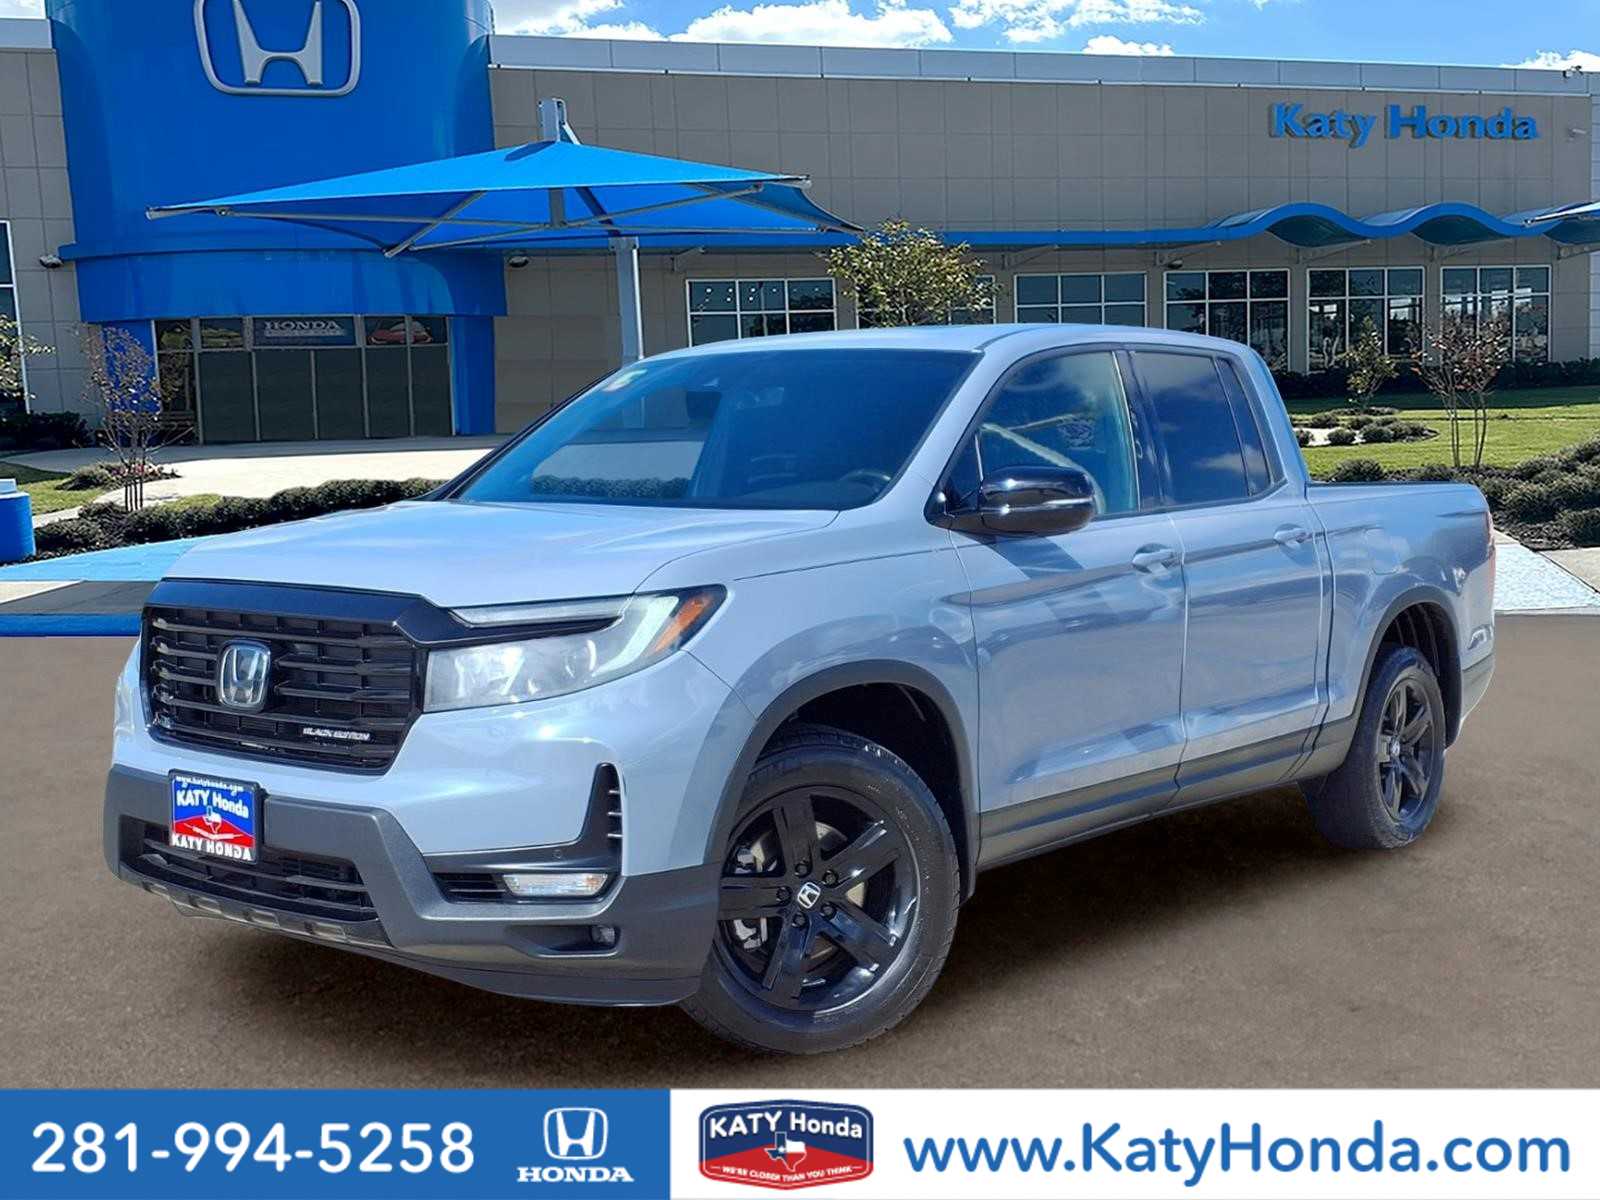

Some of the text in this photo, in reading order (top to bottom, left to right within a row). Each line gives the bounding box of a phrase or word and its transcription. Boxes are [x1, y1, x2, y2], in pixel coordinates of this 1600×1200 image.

[1270, 102, 1539, 148] Katy Honda
[264, 320, 342, 330] HONDA
[176, 789, 250, 819] KATY Honda
[171, 833, 253, 861] KATY HONDA
